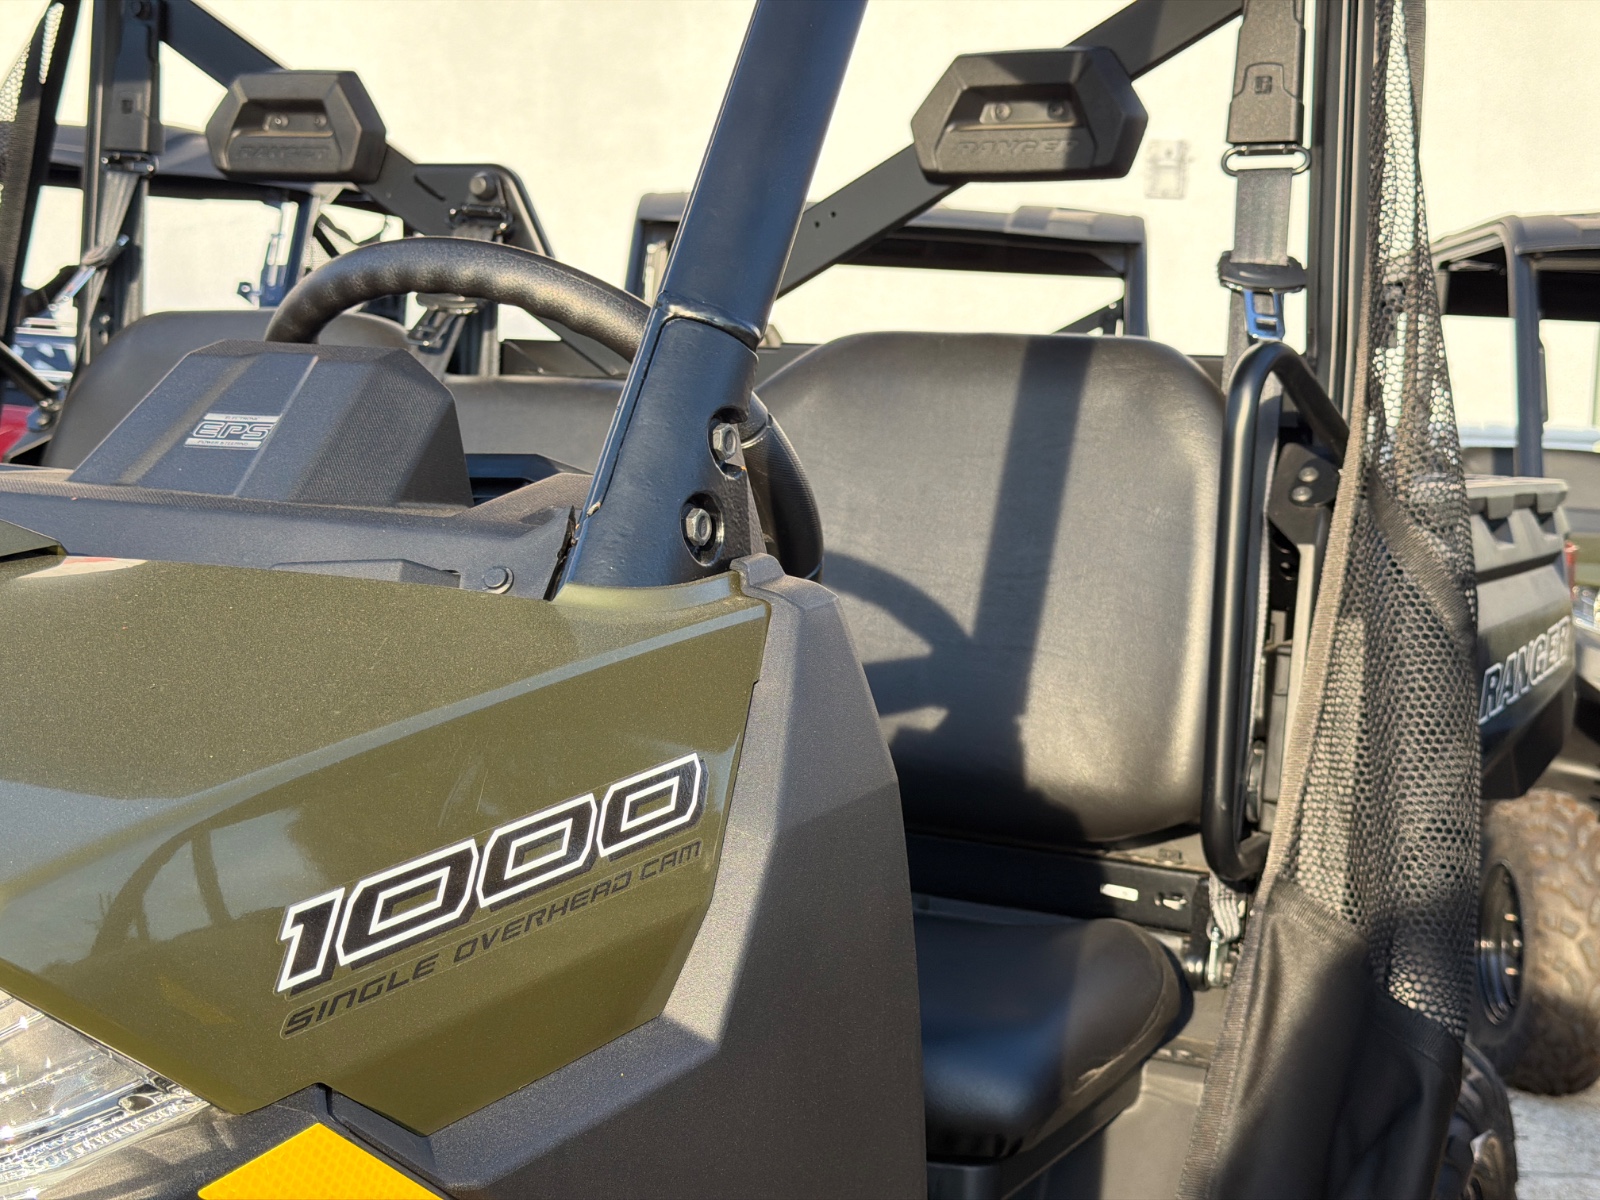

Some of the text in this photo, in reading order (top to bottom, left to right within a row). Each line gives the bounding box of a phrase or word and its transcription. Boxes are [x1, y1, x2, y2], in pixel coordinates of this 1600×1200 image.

[957, 138, 1080, 156] RANGER
[193, 421, 277, 440] EPS
[1477, 615, 1571, 725] RANGER
[277, 752, 706, 995] 1000
[284, 840, 702, 1036] SINGLE OVERHEAD CAM
